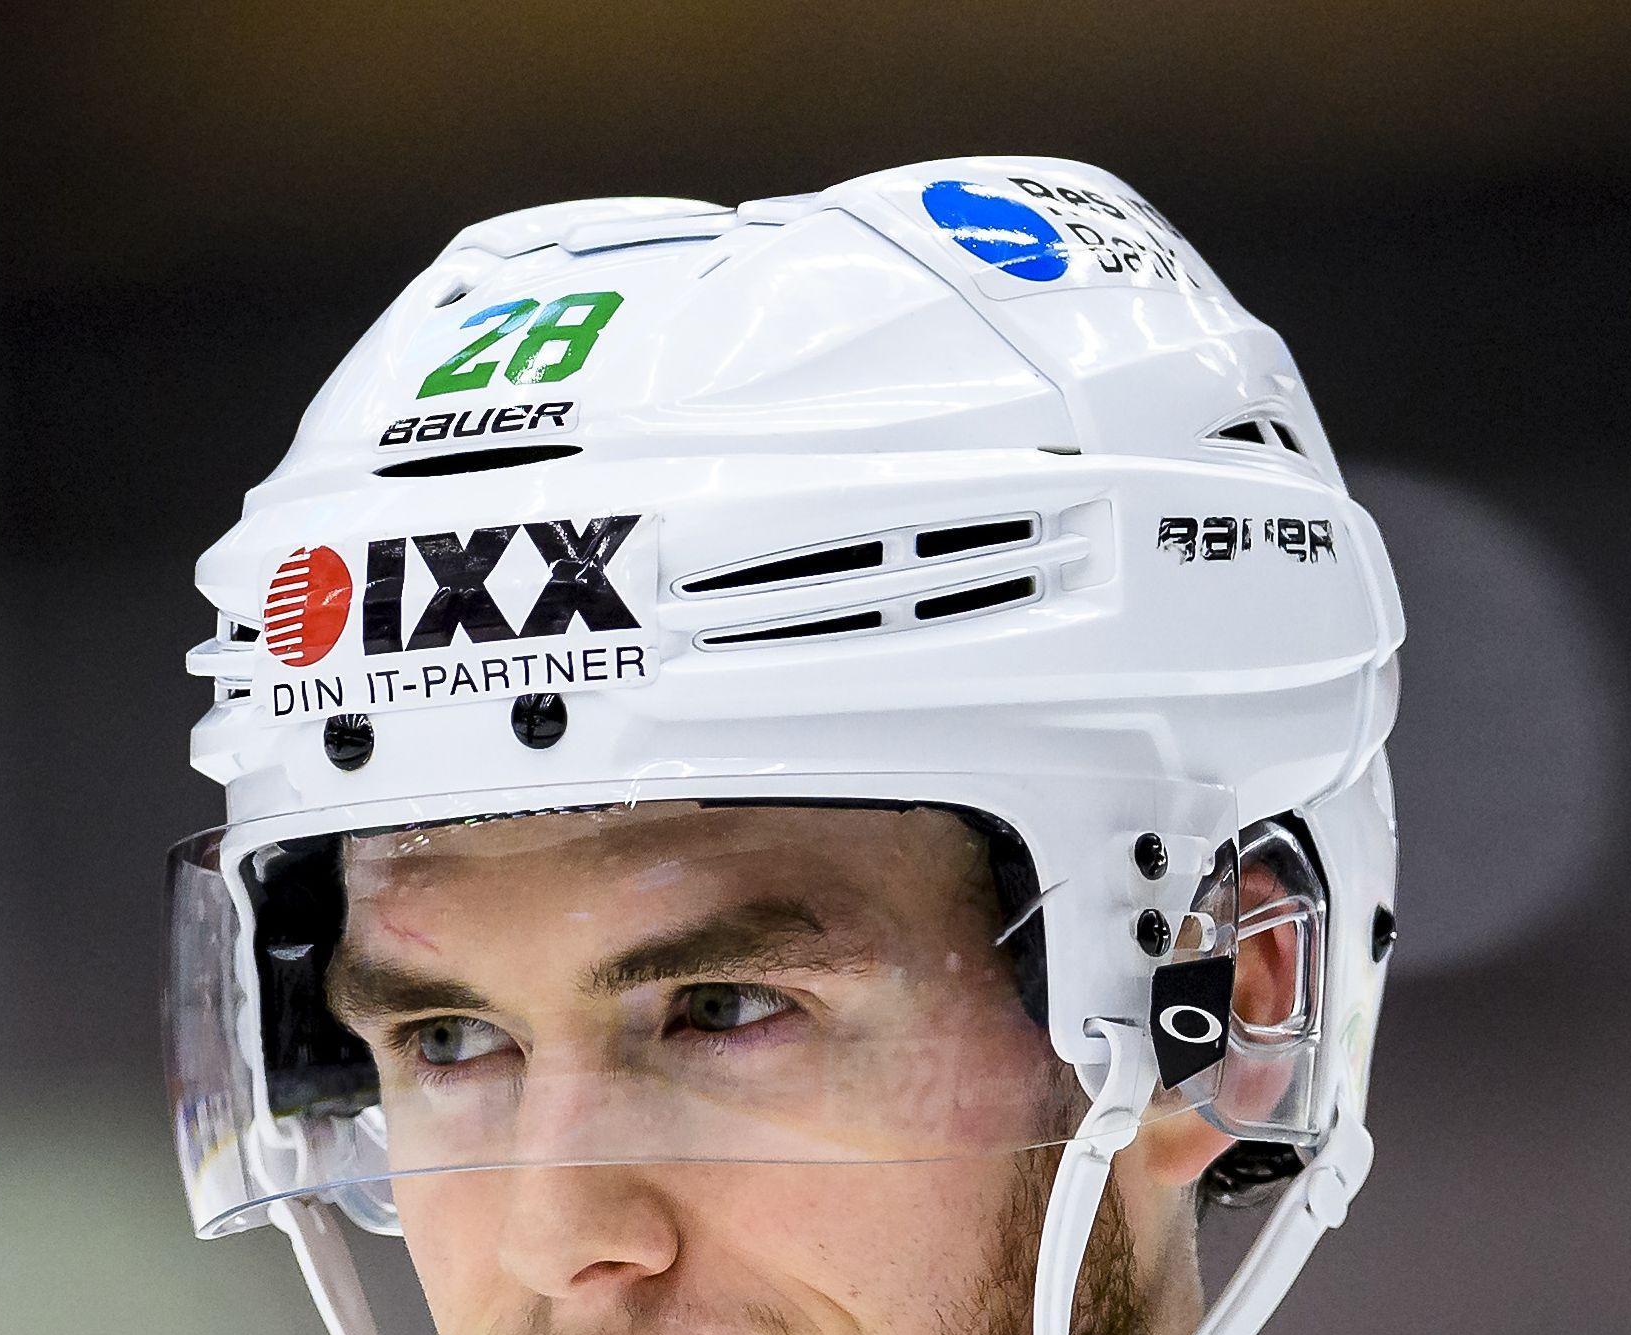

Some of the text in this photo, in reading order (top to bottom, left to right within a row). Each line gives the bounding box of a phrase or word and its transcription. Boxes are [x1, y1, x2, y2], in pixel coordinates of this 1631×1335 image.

[1007, 177, 1183, 241] Res
[416, 291, 625, 400] 28
[378, 401, 574, 447] BAUER
[362, 514, 644, 657] IXX
[273, 645, 646, 718] DIN IT-PARTNER
